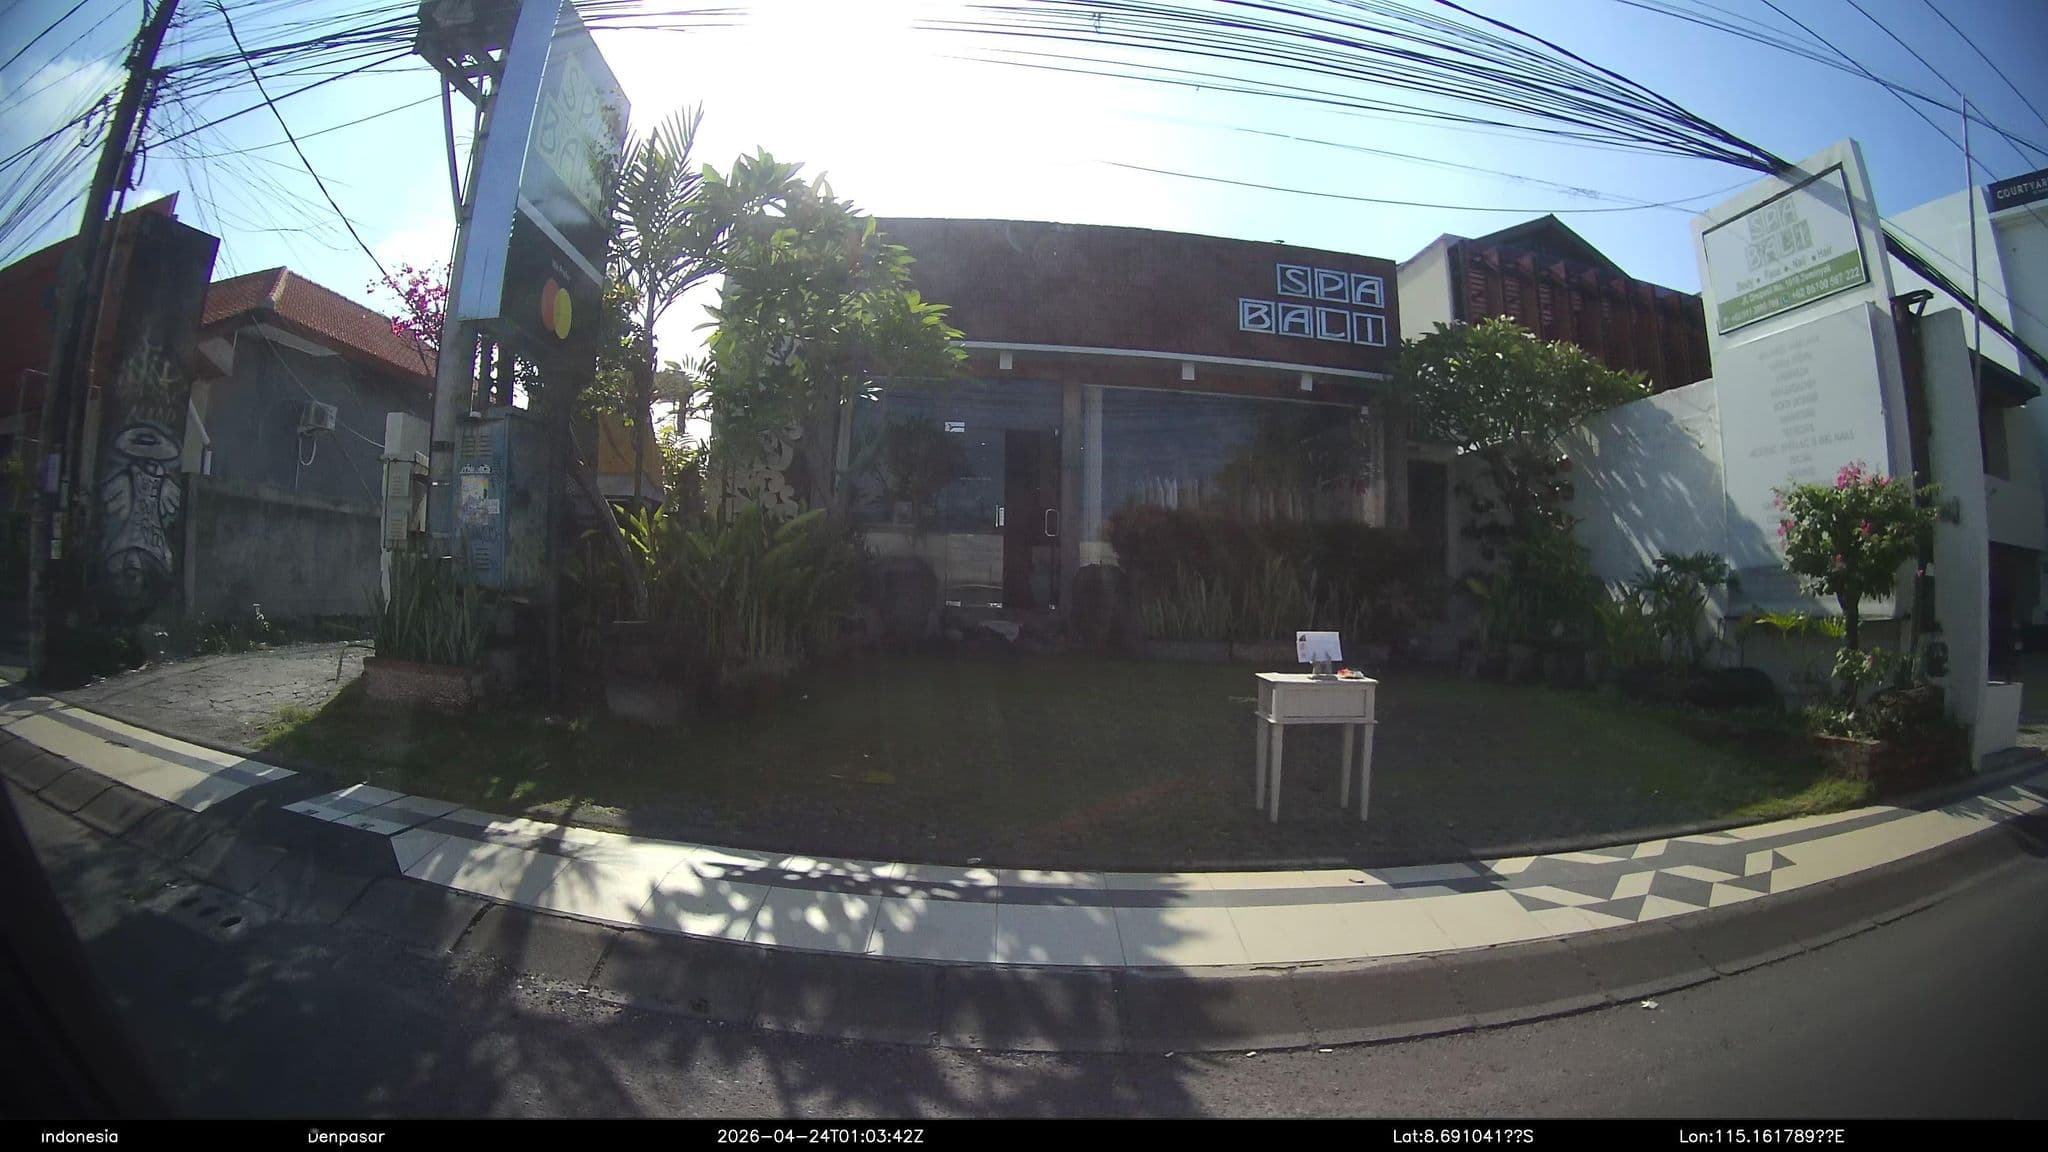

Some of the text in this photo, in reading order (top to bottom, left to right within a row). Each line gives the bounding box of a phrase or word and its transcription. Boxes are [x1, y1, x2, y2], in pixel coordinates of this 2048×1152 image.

[1996, 177, 2048, 199] COURTYAR
[1750, 197, 1797, 239] SPA
[1746, 222, 1810, 269] BALI
[1281, 267, 1382, 305] SPA
[1242, 301, 1378, 344] BALI
